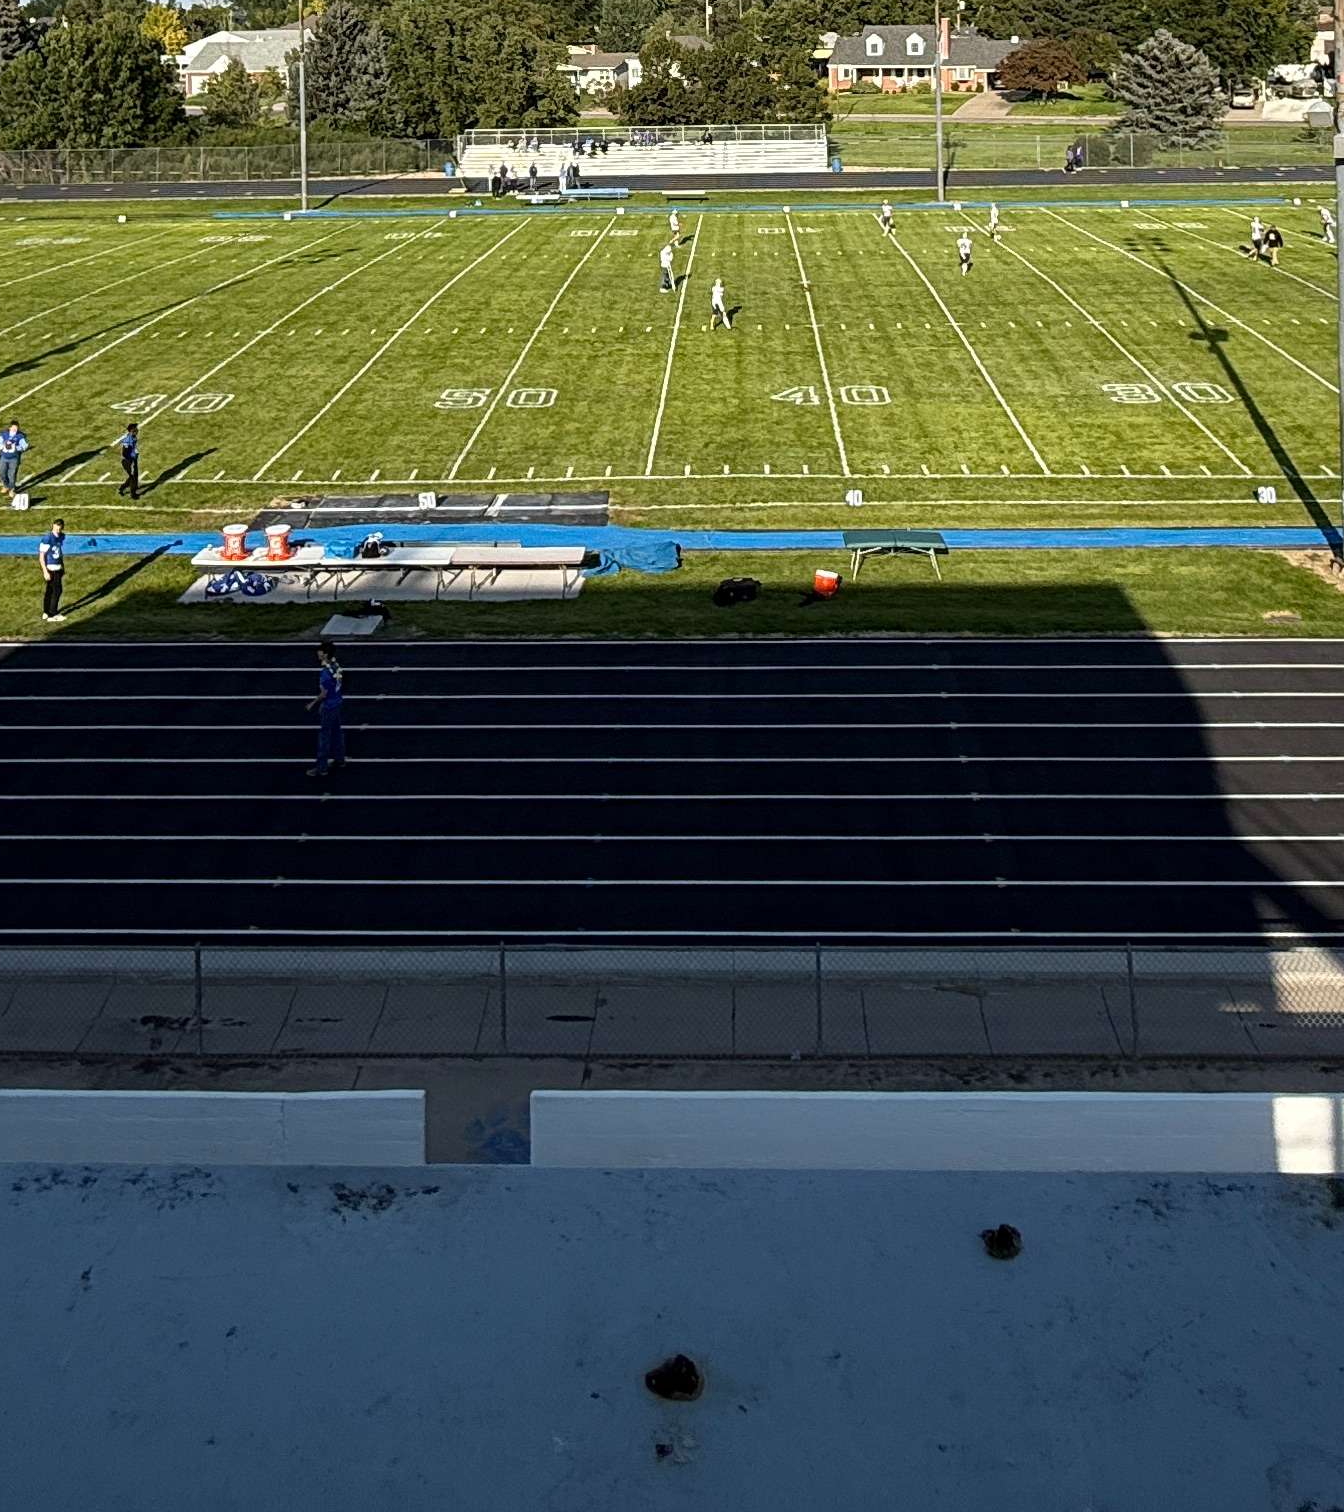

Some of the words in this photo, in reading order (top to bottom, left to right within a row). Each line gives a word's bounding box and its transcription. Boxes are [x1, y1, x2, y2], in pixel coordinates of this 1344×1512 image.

[110, 394, 236, 414] 40
[433, 388, 558, 410] 50
[771, 384, 892, 407] 40
[1101, 382, 1236, 405] 30
[1257, 486, 1276, 504] 30
